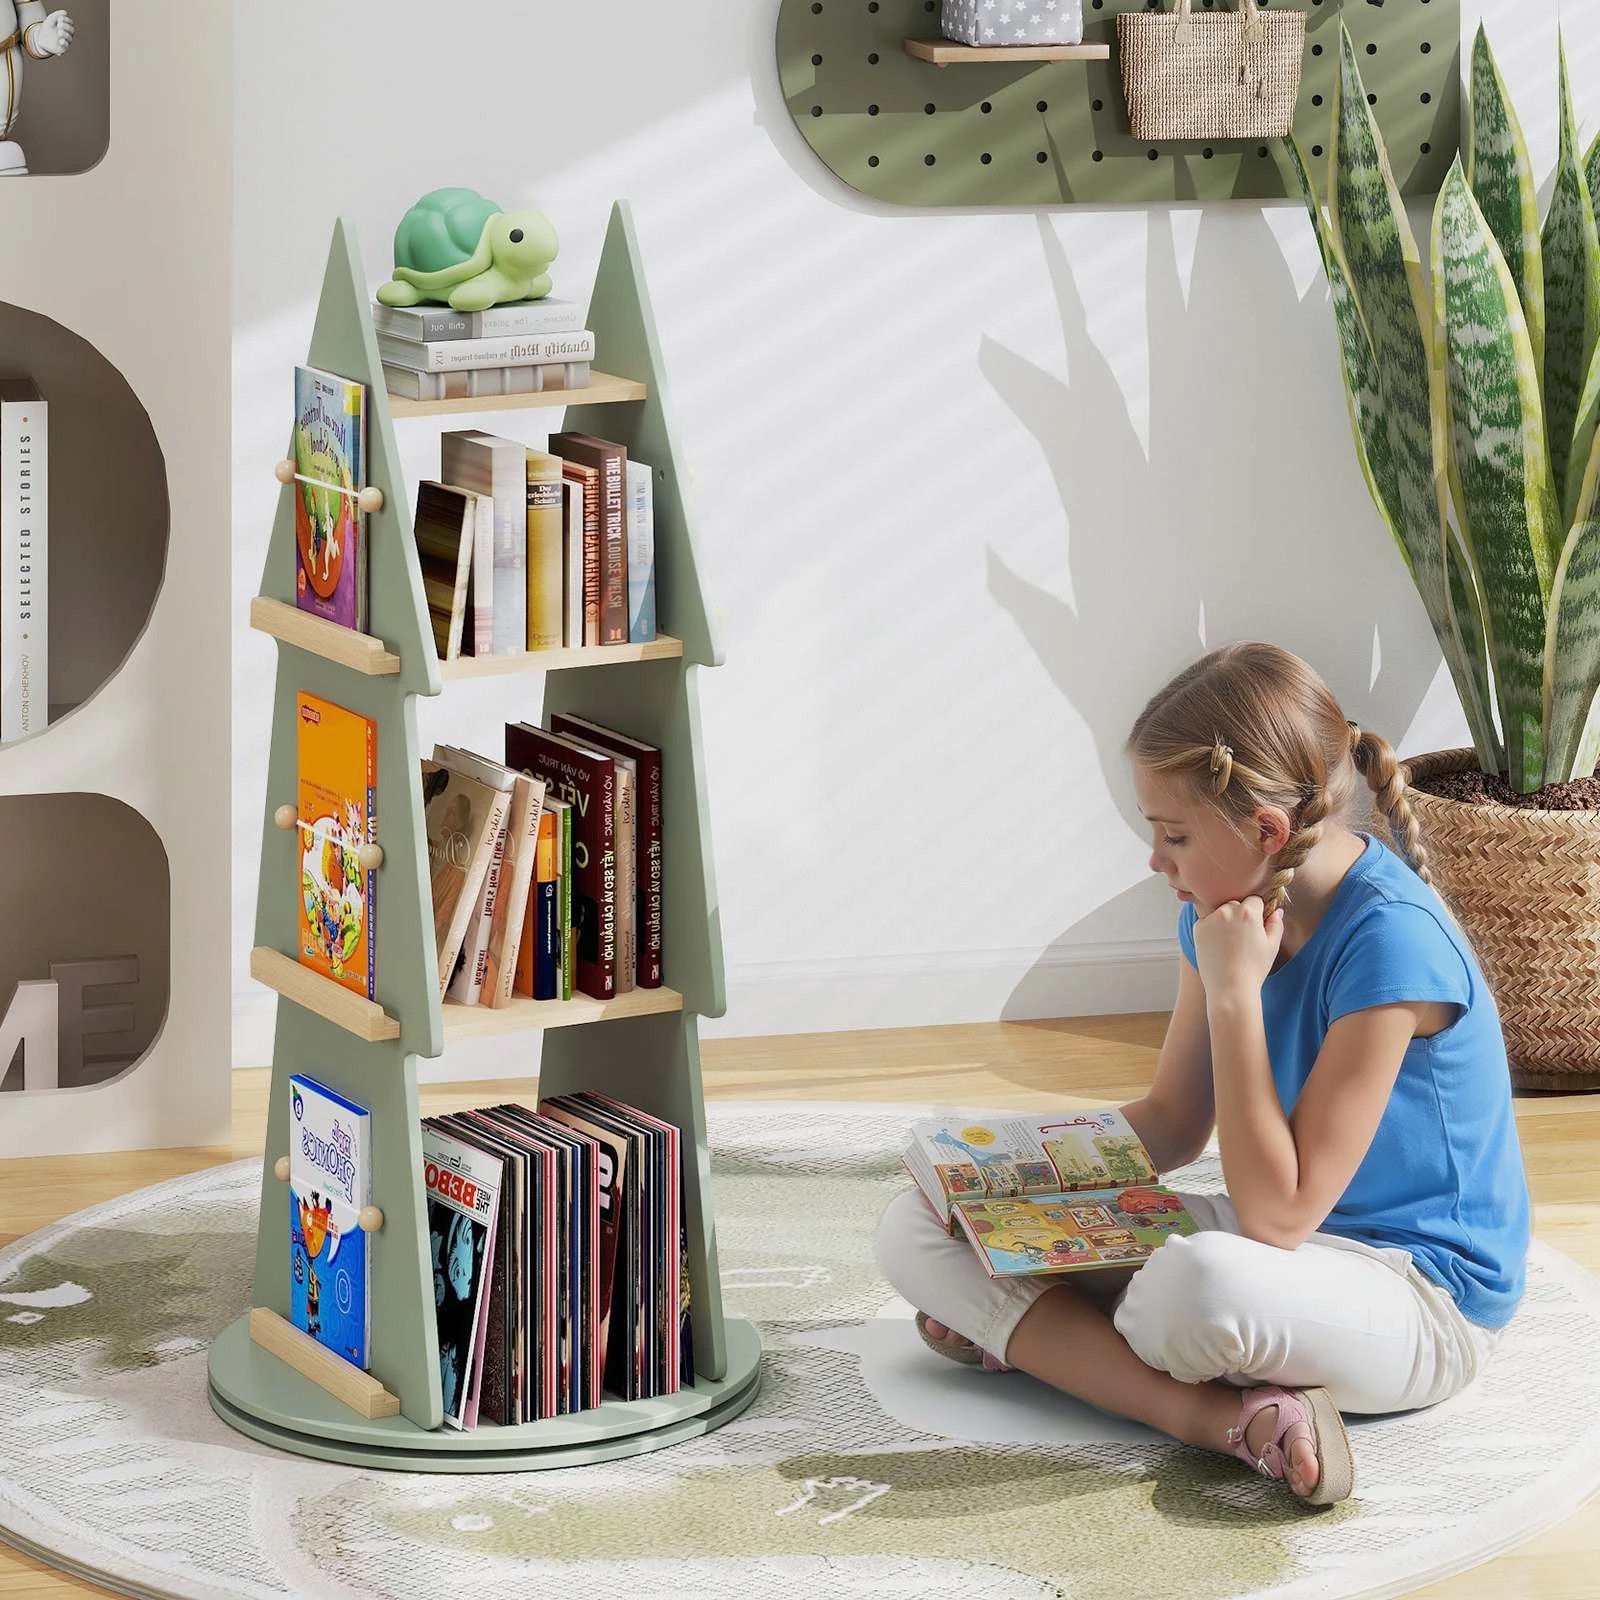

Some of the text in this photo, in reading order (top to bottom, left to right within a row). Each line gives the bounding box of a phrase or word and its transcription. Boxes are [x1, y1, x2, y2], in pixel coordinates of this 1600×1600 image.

[20, 435, 31, 620] SELECTED STORIES
[606, 457, 622, 609] THE BULLET TRICK LOUISE WELSH
[21, 654, 30, 732] ANTON CHEKHOV
